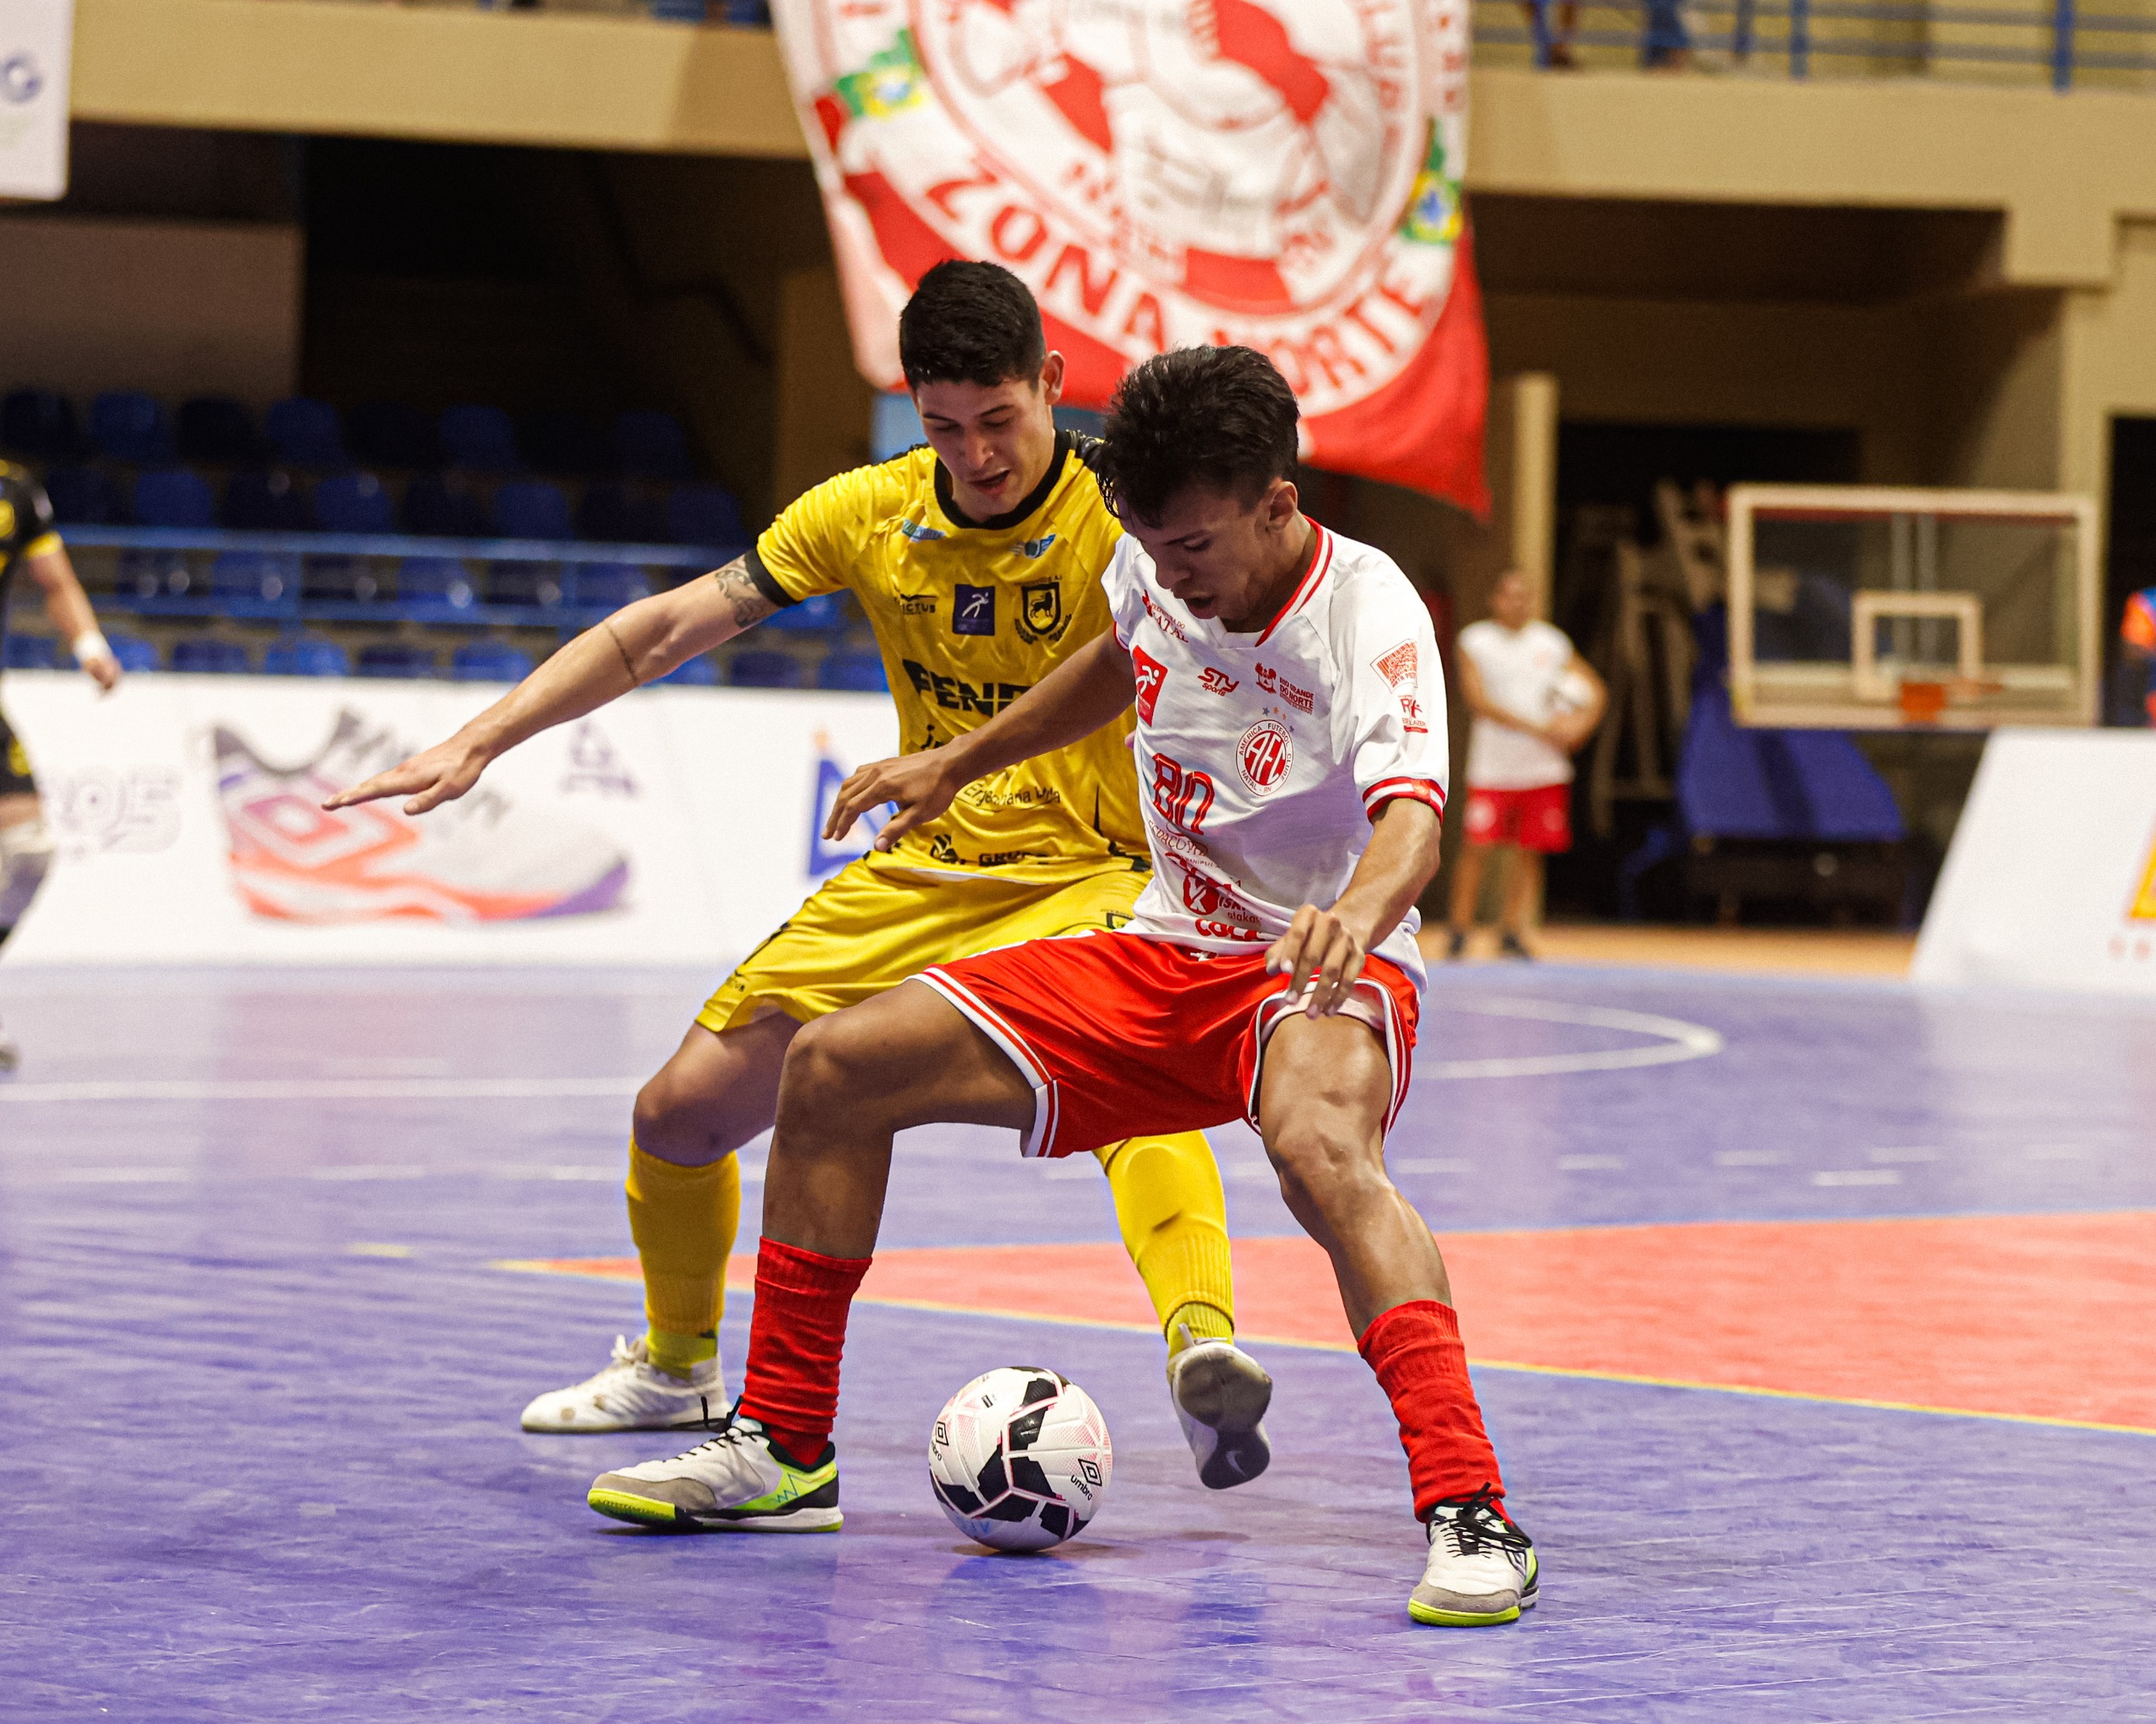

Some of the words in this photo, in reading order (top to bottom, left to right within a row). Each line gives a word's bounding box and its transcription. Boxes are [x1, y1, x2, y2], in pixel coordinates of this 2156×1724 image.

[926, 168, 1164, 354] ZONA
[1213, 280, 1423, 396] ORTE
[1198, 666, 1240, 692] STY
[1202, 682, 1226, 697] sports
[1289, 691, 1314, 709] NORTE
[1267, 723, 1290, 748] FUTEBOL
[1241, 769, 1257, 791] NATAL
[1070, 1475, 1092, 1501] umbro
